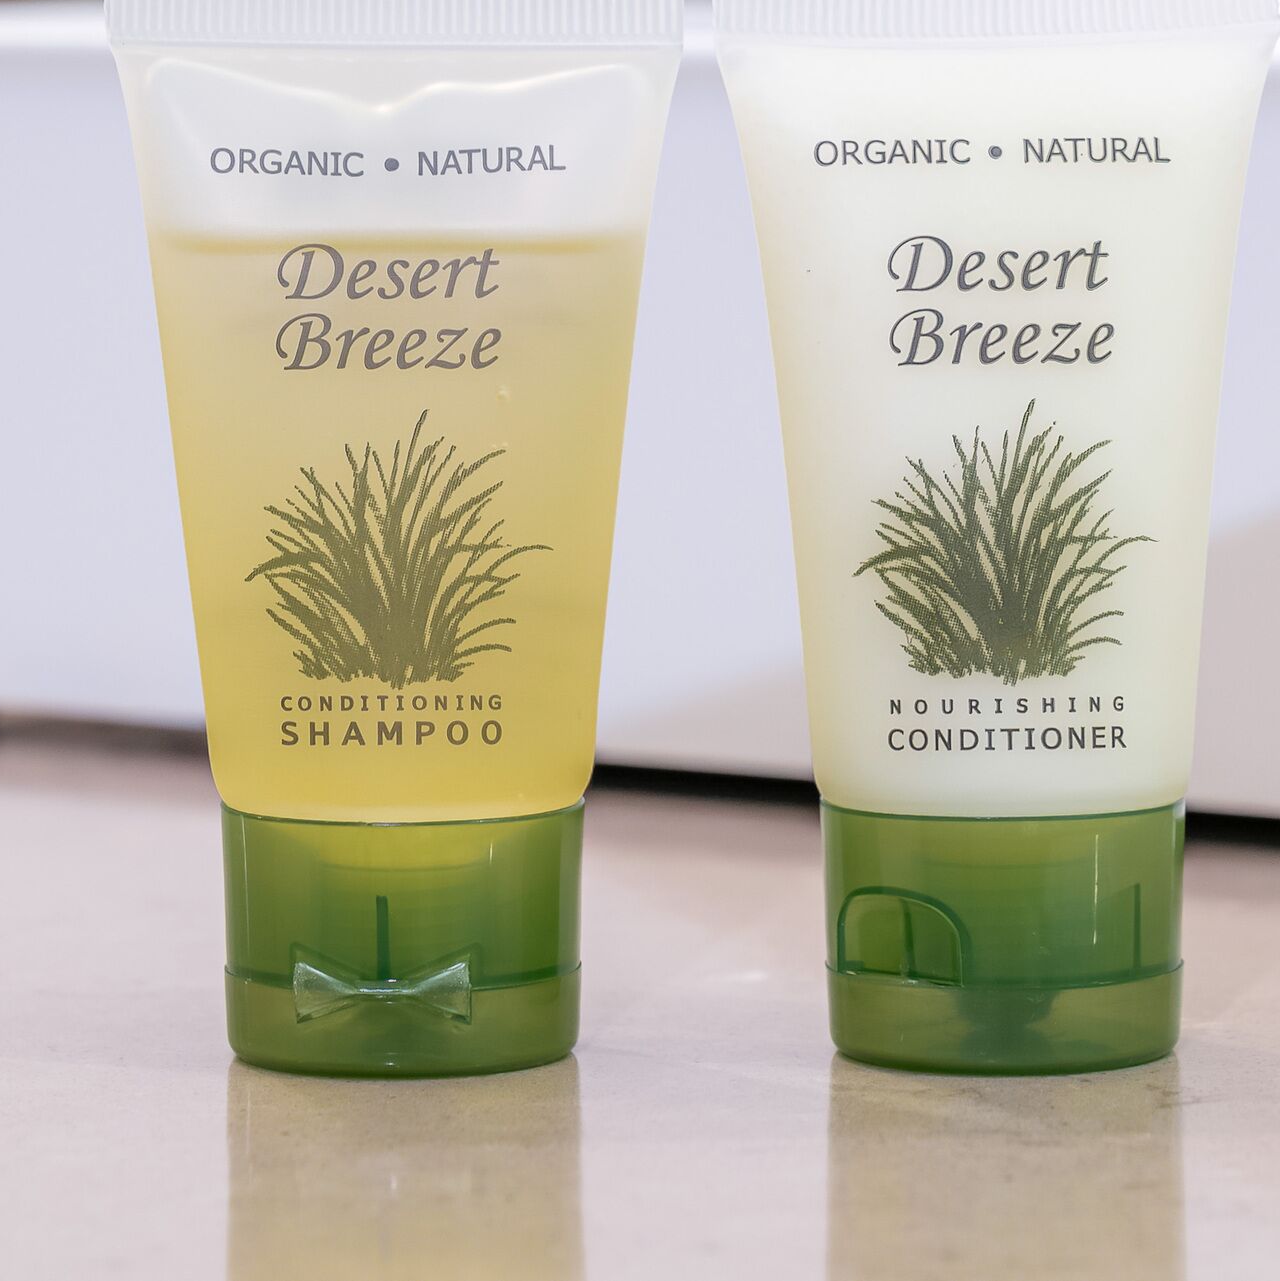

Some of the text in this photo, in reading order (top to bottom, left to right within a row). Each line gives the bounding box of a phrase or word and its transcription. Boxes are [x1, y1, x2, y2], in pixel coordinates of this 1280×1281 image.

[209, 144, 566, 177] ORGANIC NATURAL
[813, 136, 1171, 166] ORGANIC NATURAL
[276, 242, 500, 300] Desert
[886, 235, 1110, 293] Desert
[275, 312, 503, 371] Breeze
[888, 307, 1116, 367] Breeze
[280, 694, 503, 712] CONDITIONING
[889, 695, 1125, 715] NOURISHING
[280, 719, 504, 747] SHAMPOO
[887, 725, 1128, 752] CONDITIONER
